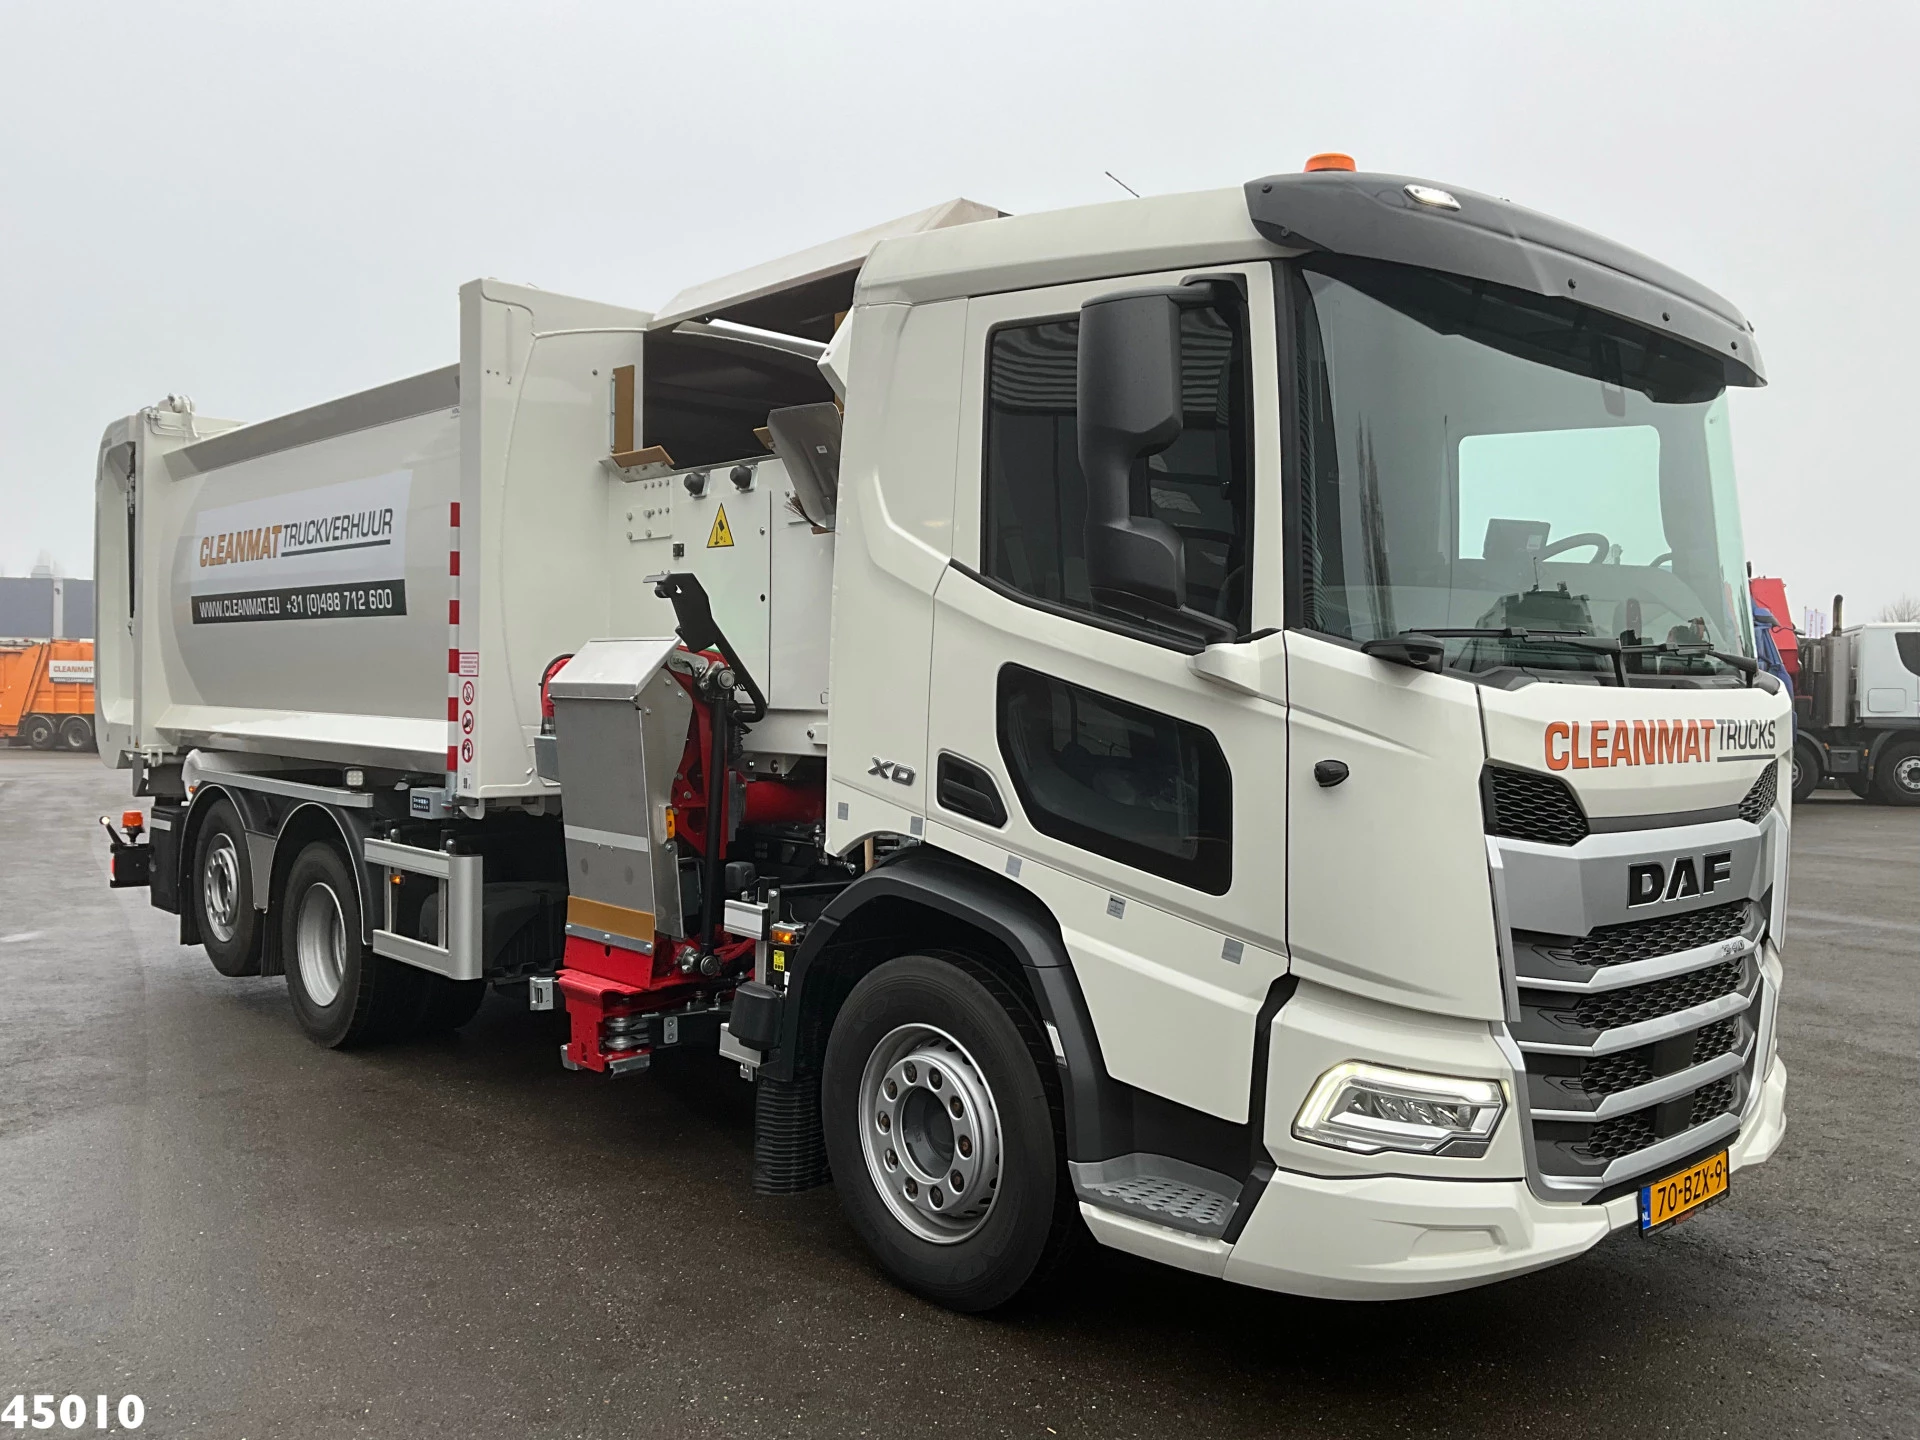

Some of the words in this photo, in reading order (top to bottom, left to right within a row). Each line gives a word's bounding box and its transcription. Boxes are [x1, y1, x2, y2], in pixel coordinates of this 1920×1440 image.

[200, 524, 282, 567] CLEANMAT
[283, 508, 393, 548] TRUCKVERHUUR
[199, 597, 280, 618] WWW.CLEANMAT.EU
[286, 595, 304, 614] +31
[307, 592, 341, 615] (0)488
[343, 590, 366, 611] 712
[369, 588, 393, 609] 600
[1545, 719, 1716, 771] CLEANMAT
[1716, 719, 1776, 750] TRUCKS
[1627, 849, 1732, 909] DAF
[1657, 1159, 1723, 1217] 70-BZX-9
[1642, 1211, 1651, 1222] NL
